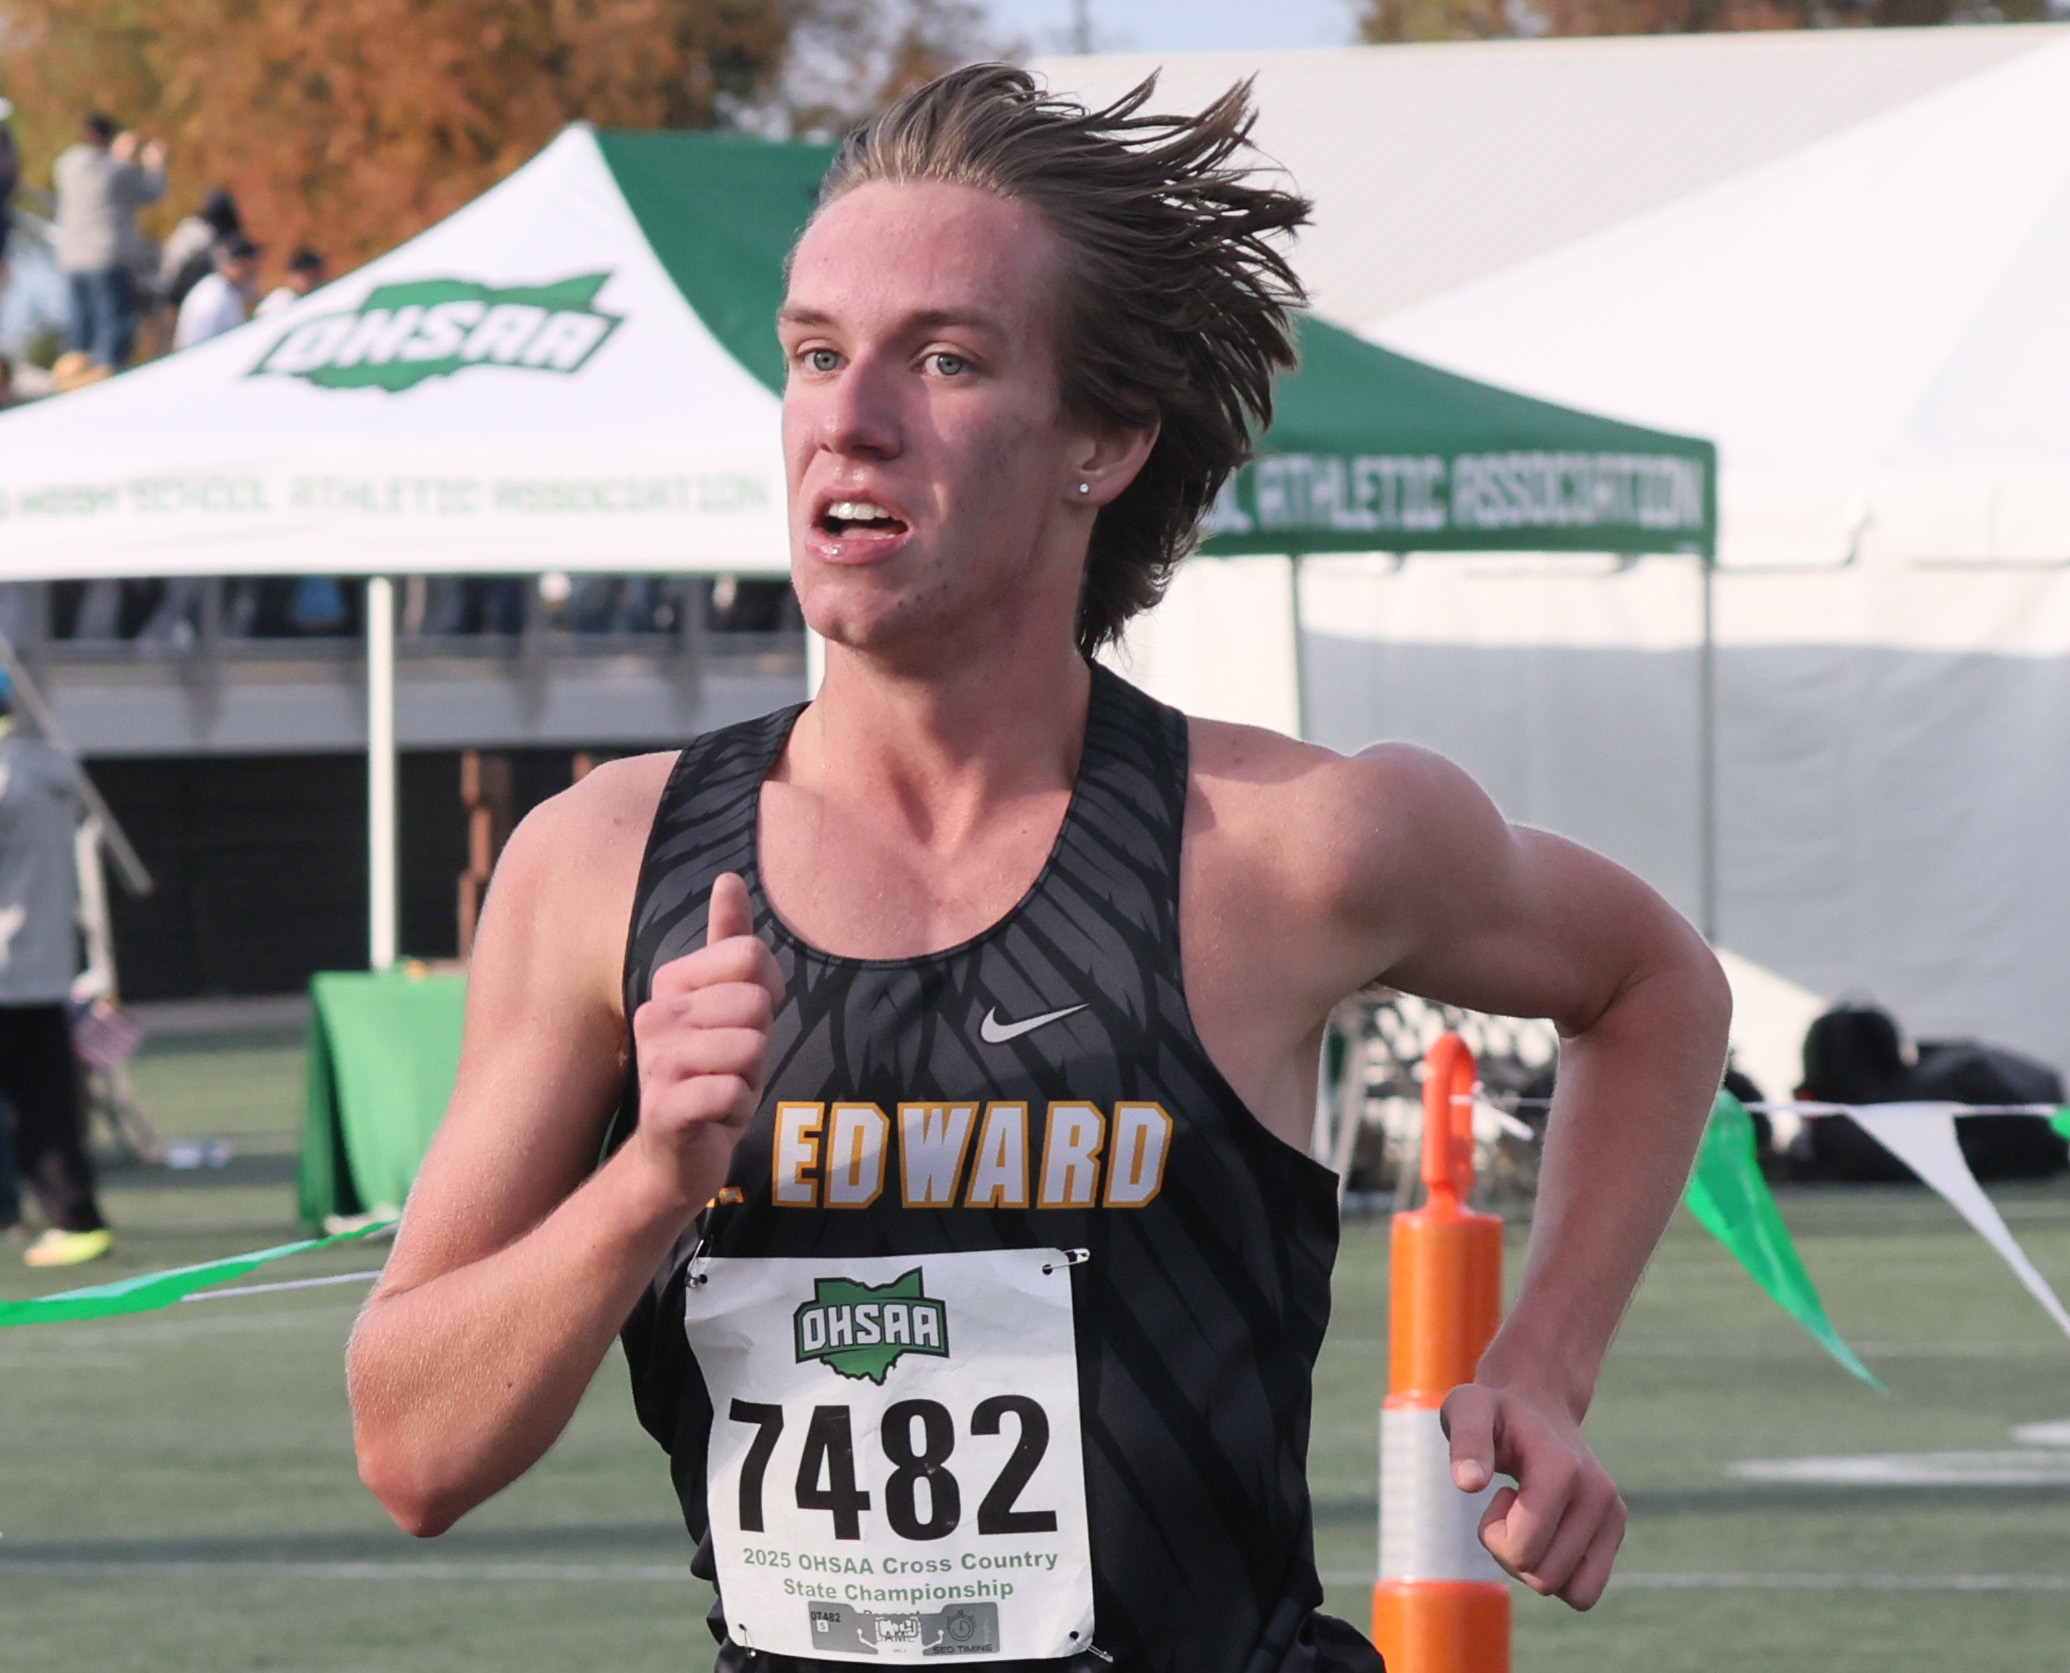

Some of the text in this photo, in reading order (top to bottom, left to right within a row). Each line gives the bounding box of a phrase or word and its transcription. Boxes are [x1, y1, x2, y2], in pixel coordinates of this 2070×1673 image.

[262, 300, 610, 371] OHSAA
[1255, 455, 1445, 530] ATHLETIC
[772, 1101, 1174, 1209] EDWARD
[802, 1303, 942, 1352] OHSAA
[728, 1395, 1058, 1541] 7482
[743, 1547, 1058, 1575] 2025 OHSAA Cross Country
[783, 1578, 1014, 1605] State Championship
[810, 1611, 841, 1622] 07482
